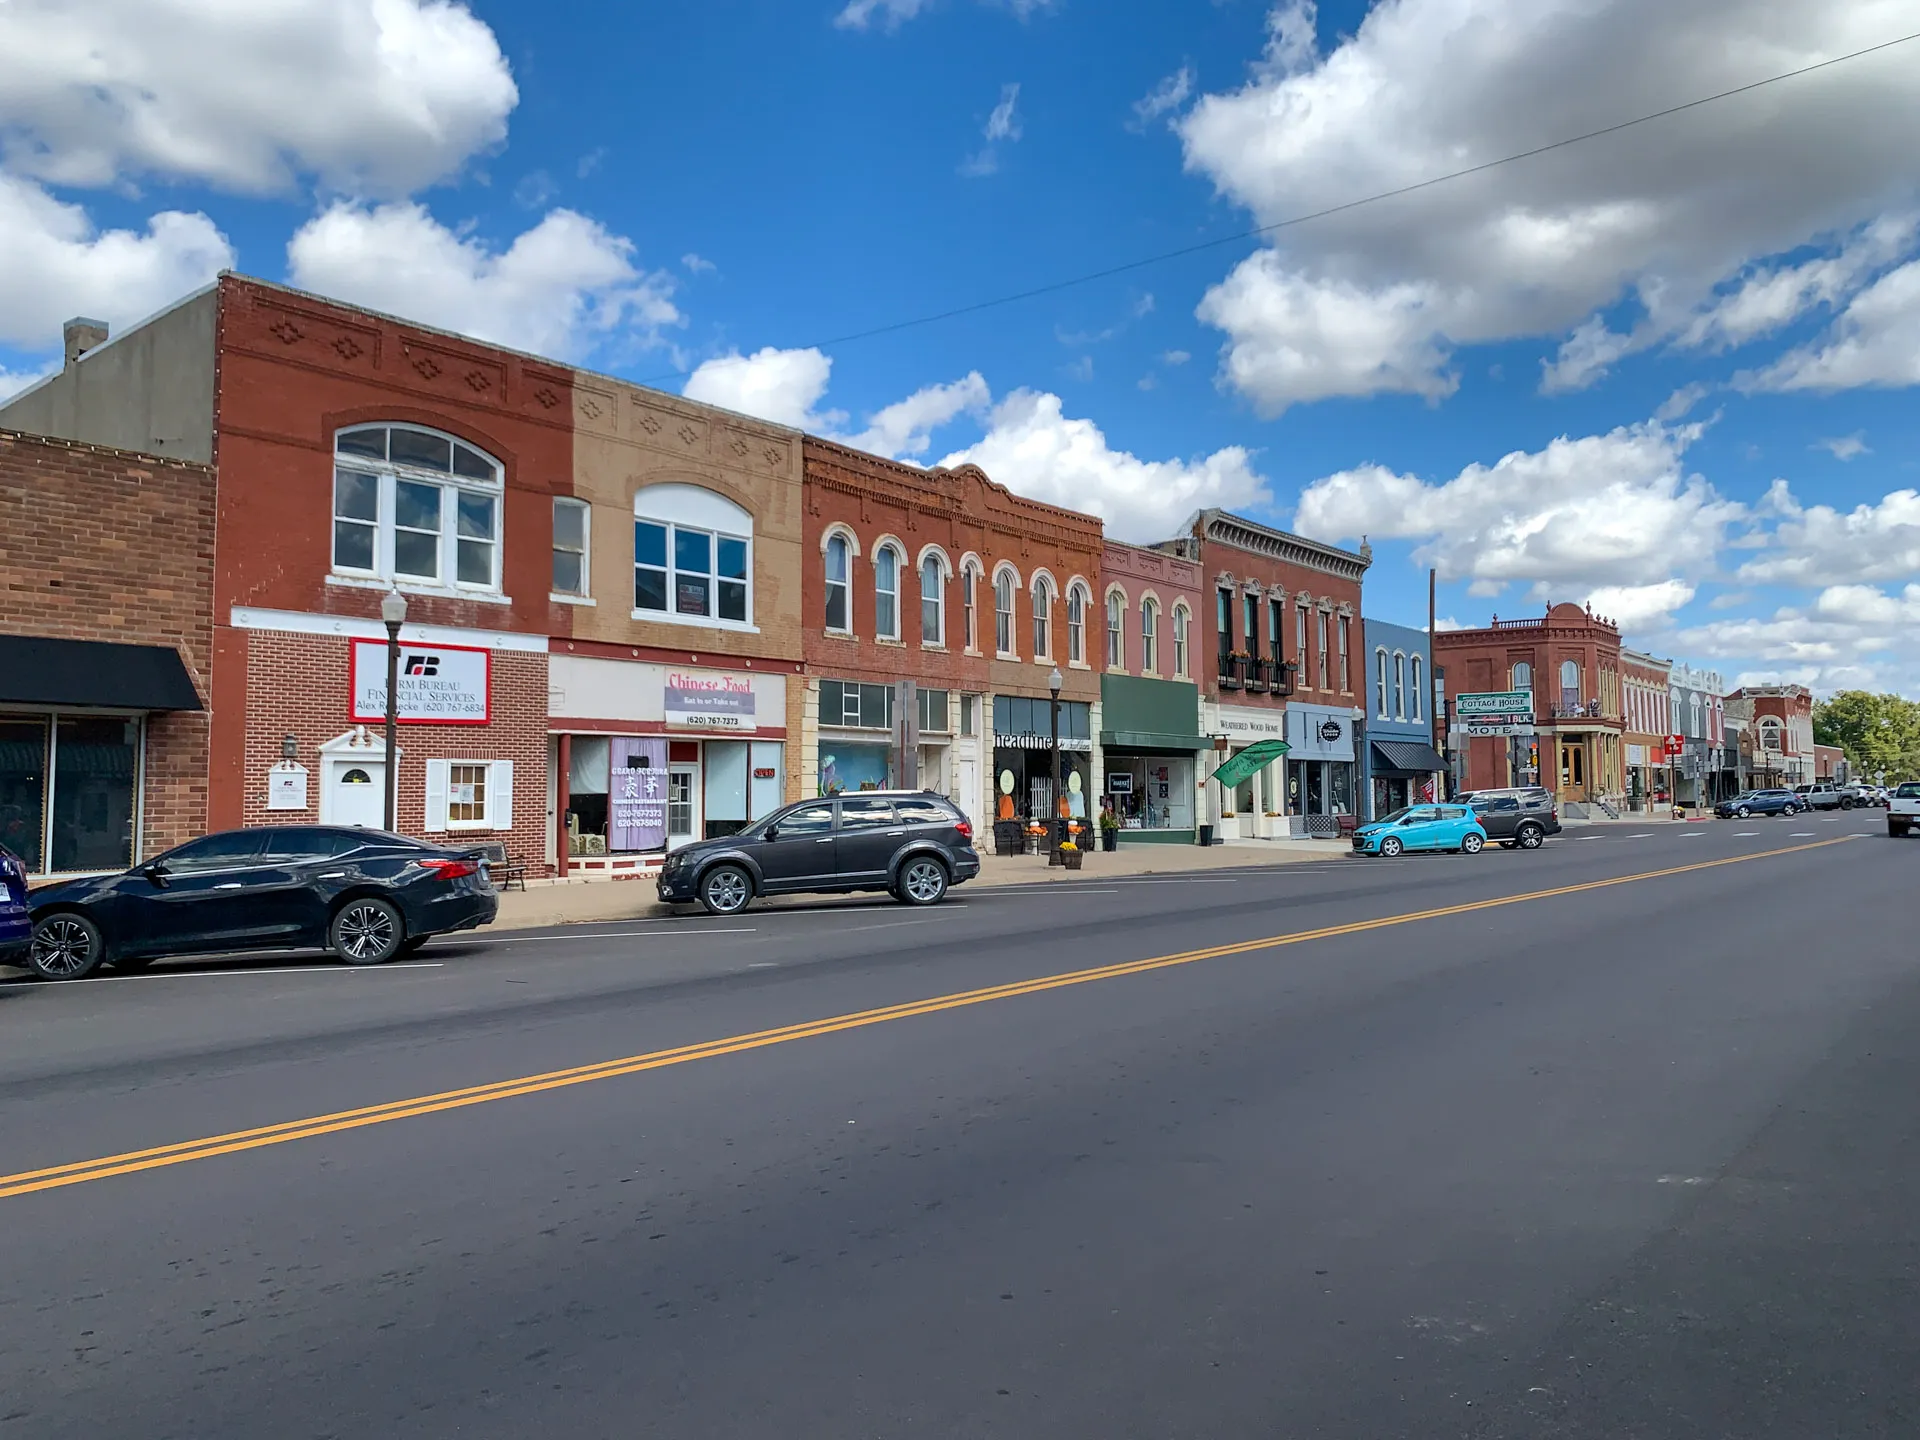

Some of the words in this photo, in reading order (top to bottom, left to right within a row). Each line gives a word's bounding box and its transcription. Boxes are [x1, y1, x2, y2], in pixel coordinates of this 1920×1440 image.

[419, 680, 460, 692] BUREAU
[669, 673, 718, 691] Chinese
[723, 676, 751, 694] Food
[367, 689, 425, 701] FINNCIAL
[429, 691, 476, 703] SERVICES
[684, 696, 696, 704] Eat
[356, 700, 377, 711] Alex
[379, 701, 419, 711] Recke
[423, 702, 445, 713] (620)
[447, 702, 485, 713] 767-6834
[1462, 699, 1497, 708] COTTAGE
[1499, 698, 1525, 708] HOUSE
[686, 716, 706, 725] (620)
[707, 717, 738, 726] 767-7373
[1220, 720, 1249, 731] WEATHERED
[1250, 721, 1265, 732] WOOD
[1265, 723, 1279, 733] HOME
